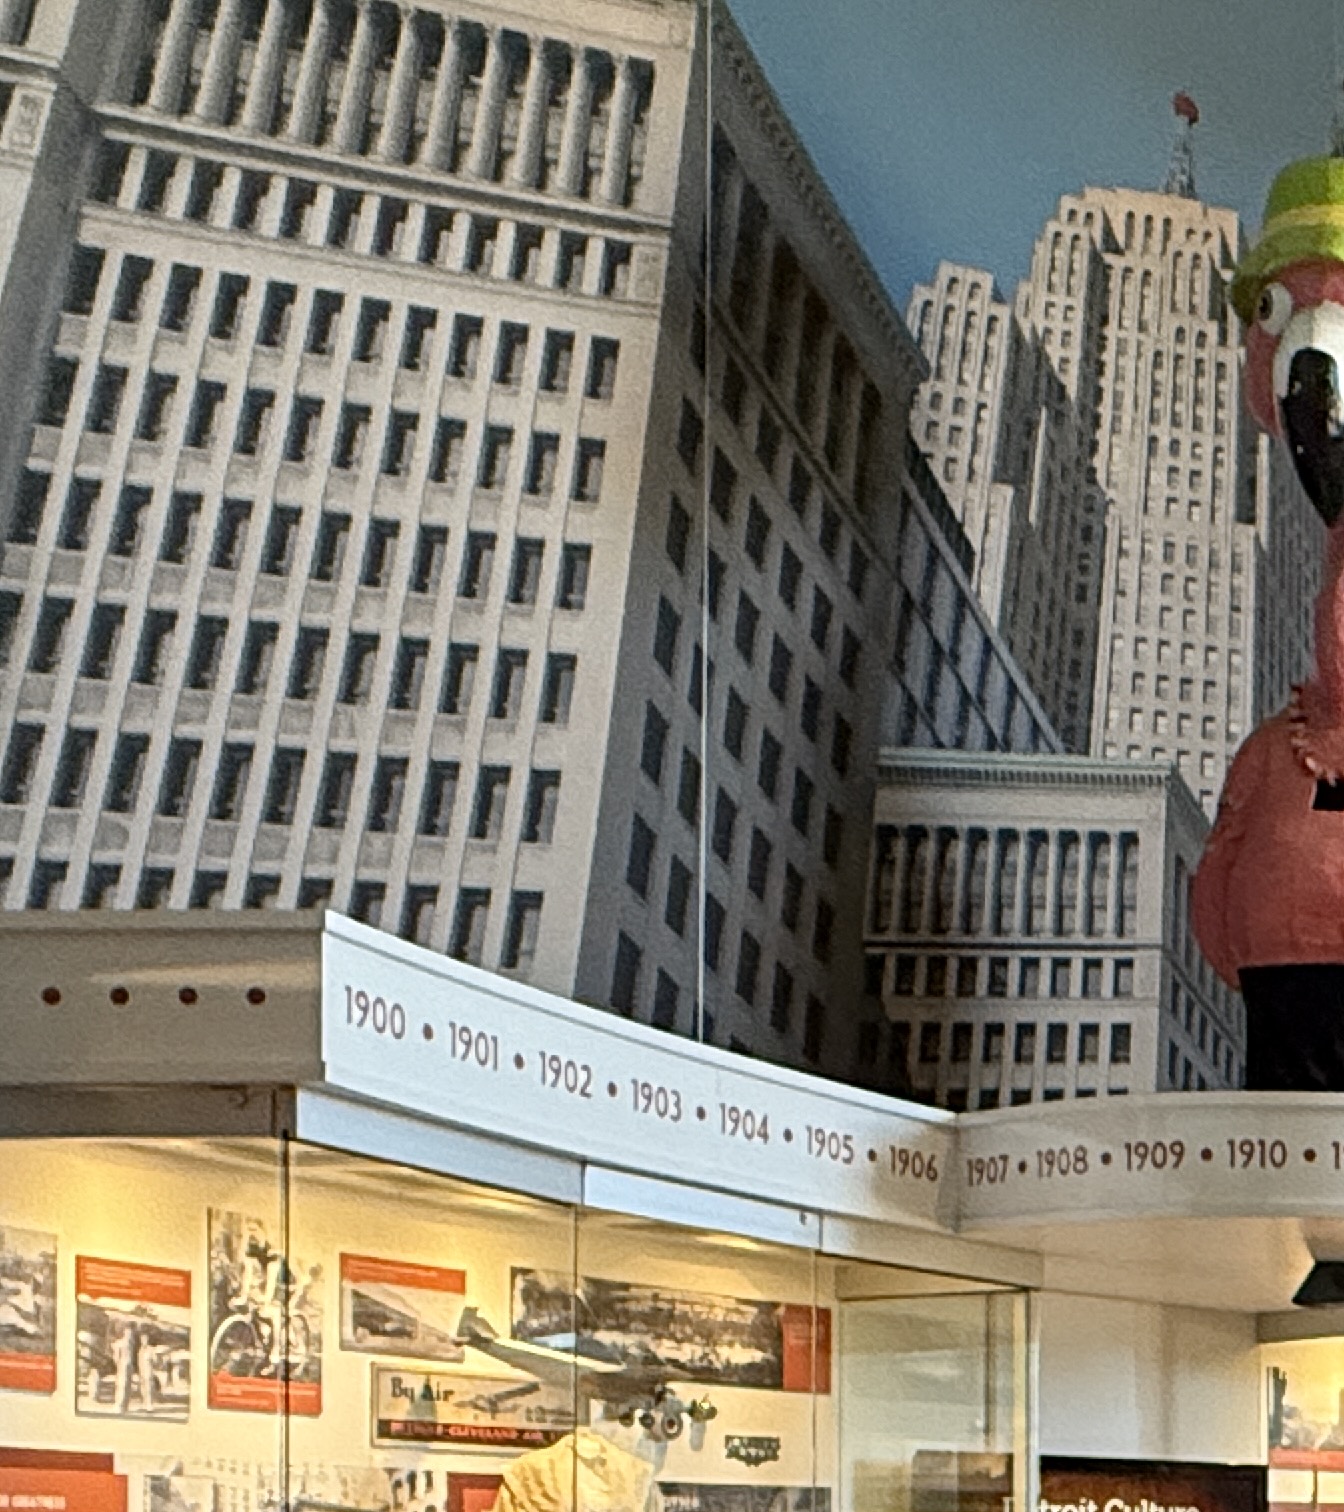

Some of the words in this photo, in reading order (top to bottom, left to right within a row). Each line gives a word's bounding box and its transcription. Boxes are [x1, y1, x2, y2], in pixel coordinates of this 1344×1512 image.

[344, 984, 406, 1042] 1900
[448, 1021, 499, 1073] 1901
[538, 1051, 593, 1099] 1902
[631, 1078, 683, 1122] 1903
[718, 1102, 770, 1145] 1904
[804, 1124, 855, 1164] 1905
[888, 1145, 939, 1182] 1906
[966, 1155, 1009, 1188] 1907
[1036, 1145, 1089, 1179] 1908
[1124, 1140, 1186, 1172] 1909
[1226, 1138, 1288, 1170] 1910
